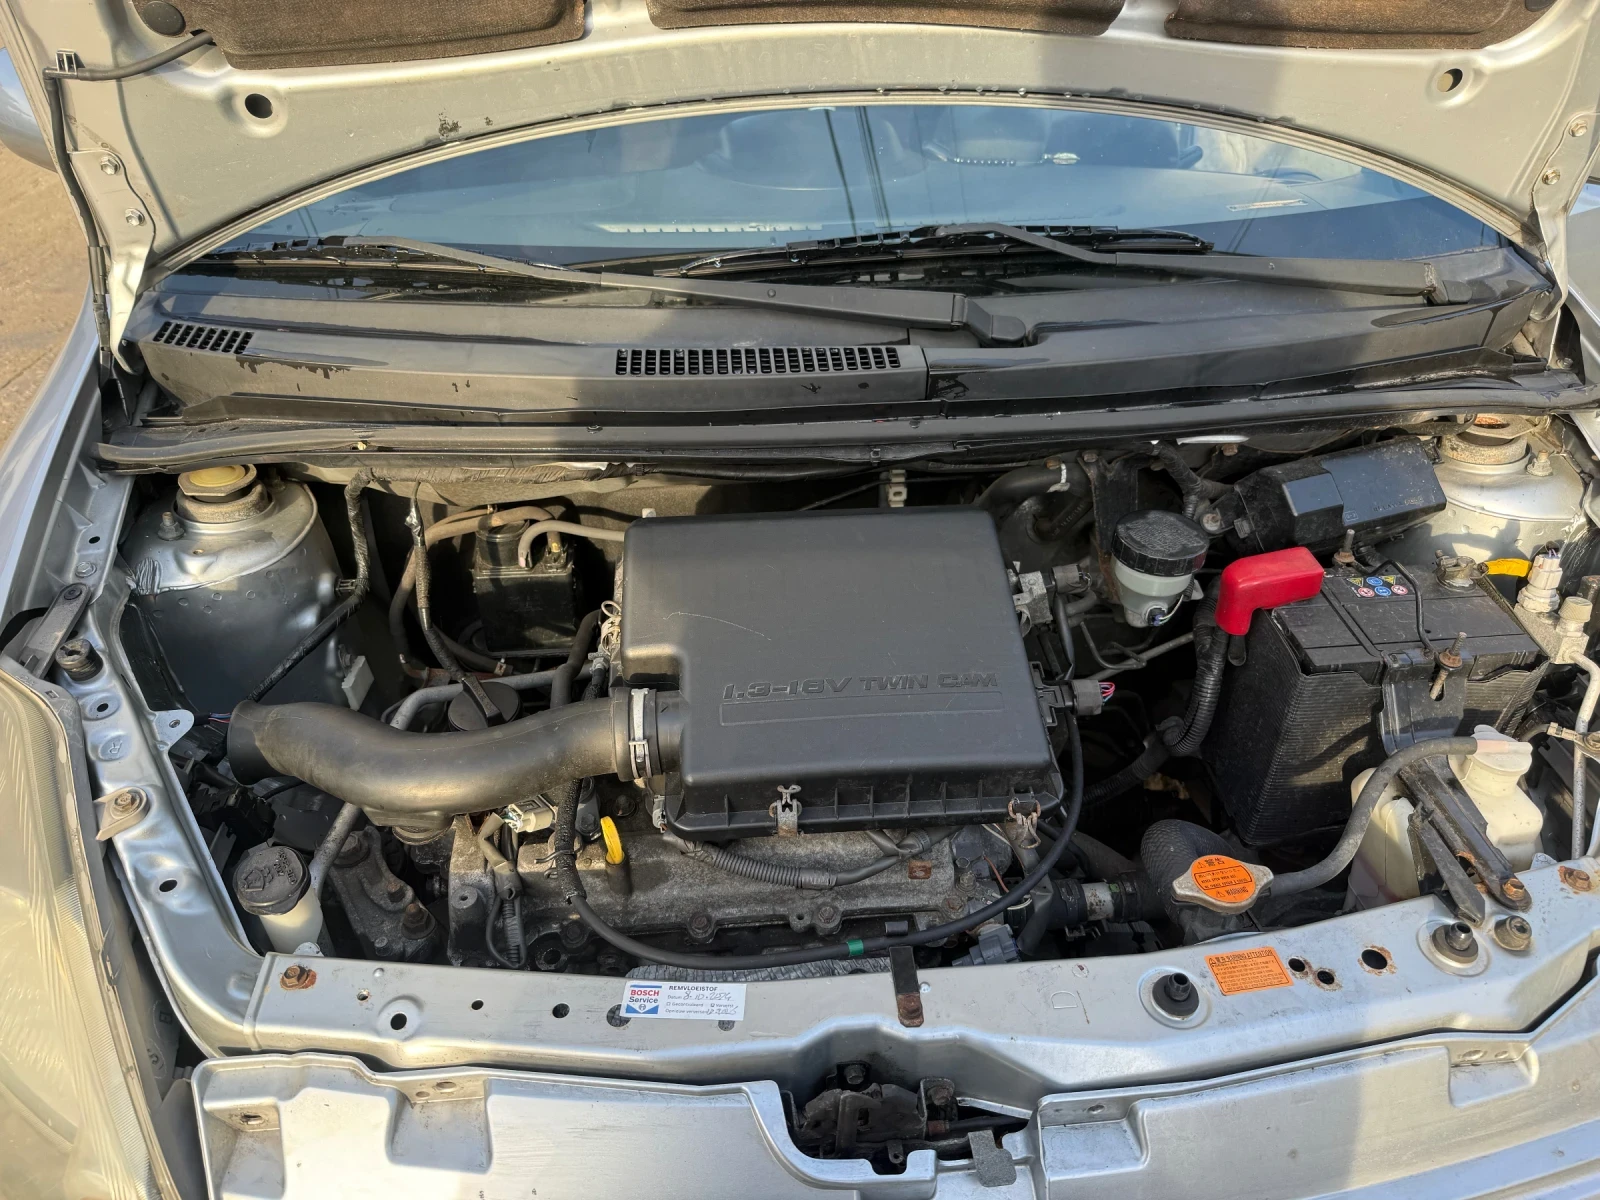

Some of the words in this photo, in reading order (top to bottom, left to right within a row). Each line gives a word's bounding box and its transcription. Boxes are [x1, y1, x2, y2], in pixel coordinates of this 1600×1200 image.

[859, 674, 928, 691] TWIN
[937, 672, 998, 688] CAM
[630, 989, 660, 997] BOSCH
[629, 996, 658, 1004] Service
